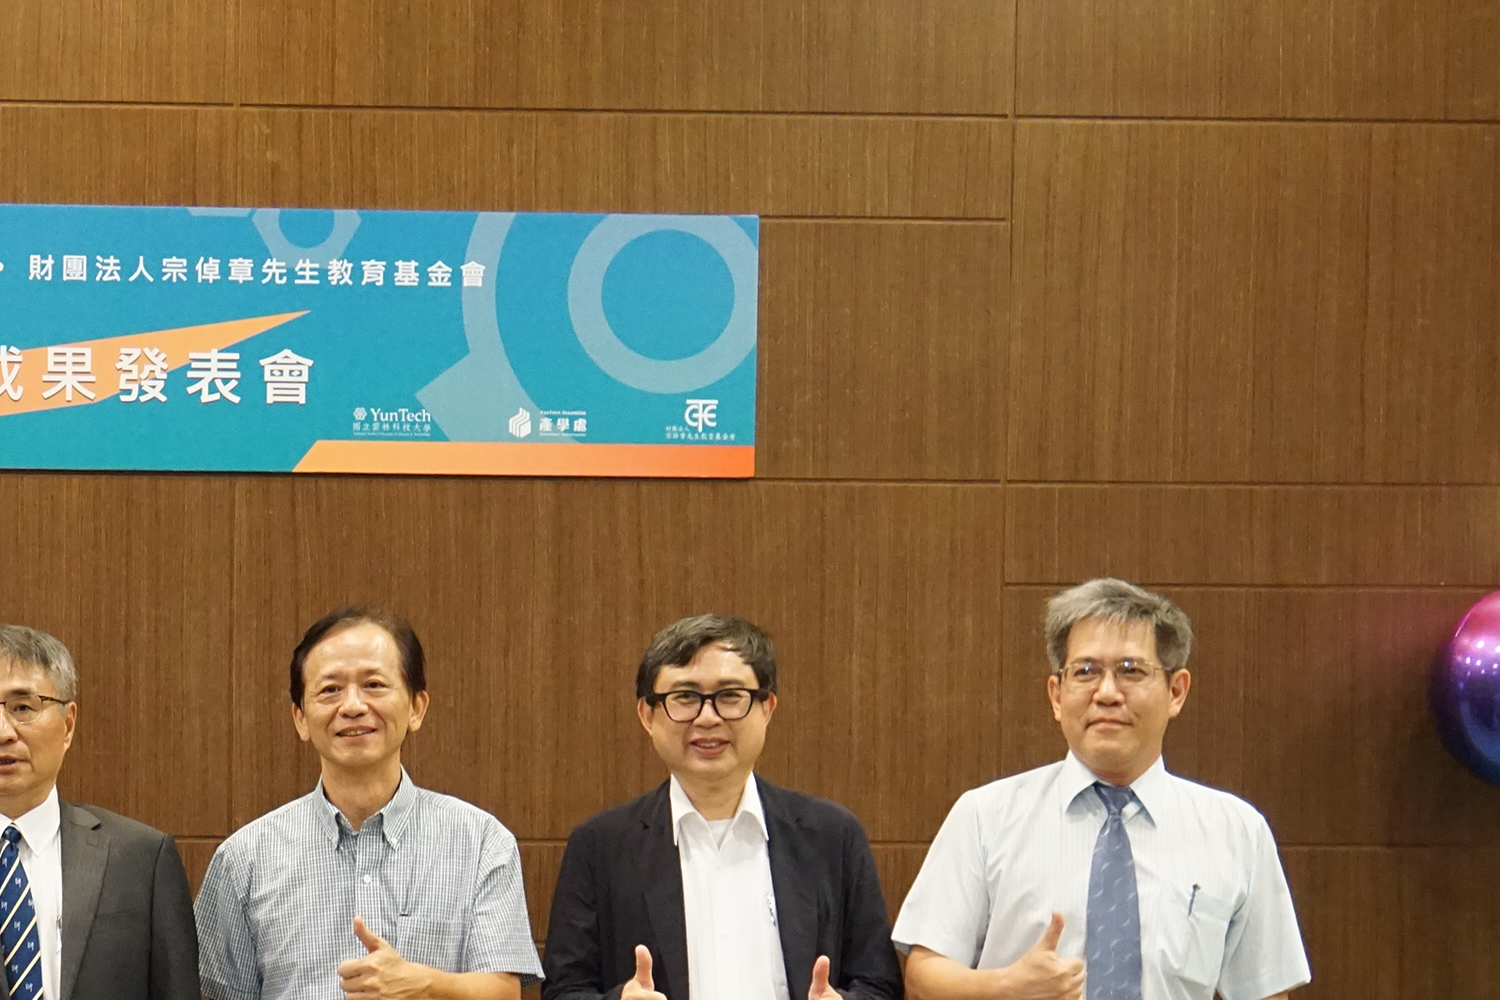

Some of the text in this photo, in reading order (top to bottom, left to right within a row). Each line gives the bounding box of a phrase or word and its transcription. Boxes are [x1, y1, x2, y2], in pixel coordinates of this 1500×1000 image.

[28, 254, 486, 288] 財團法人宗倬章先生教育基金會
[370, 408, 431, 422] YunTech
